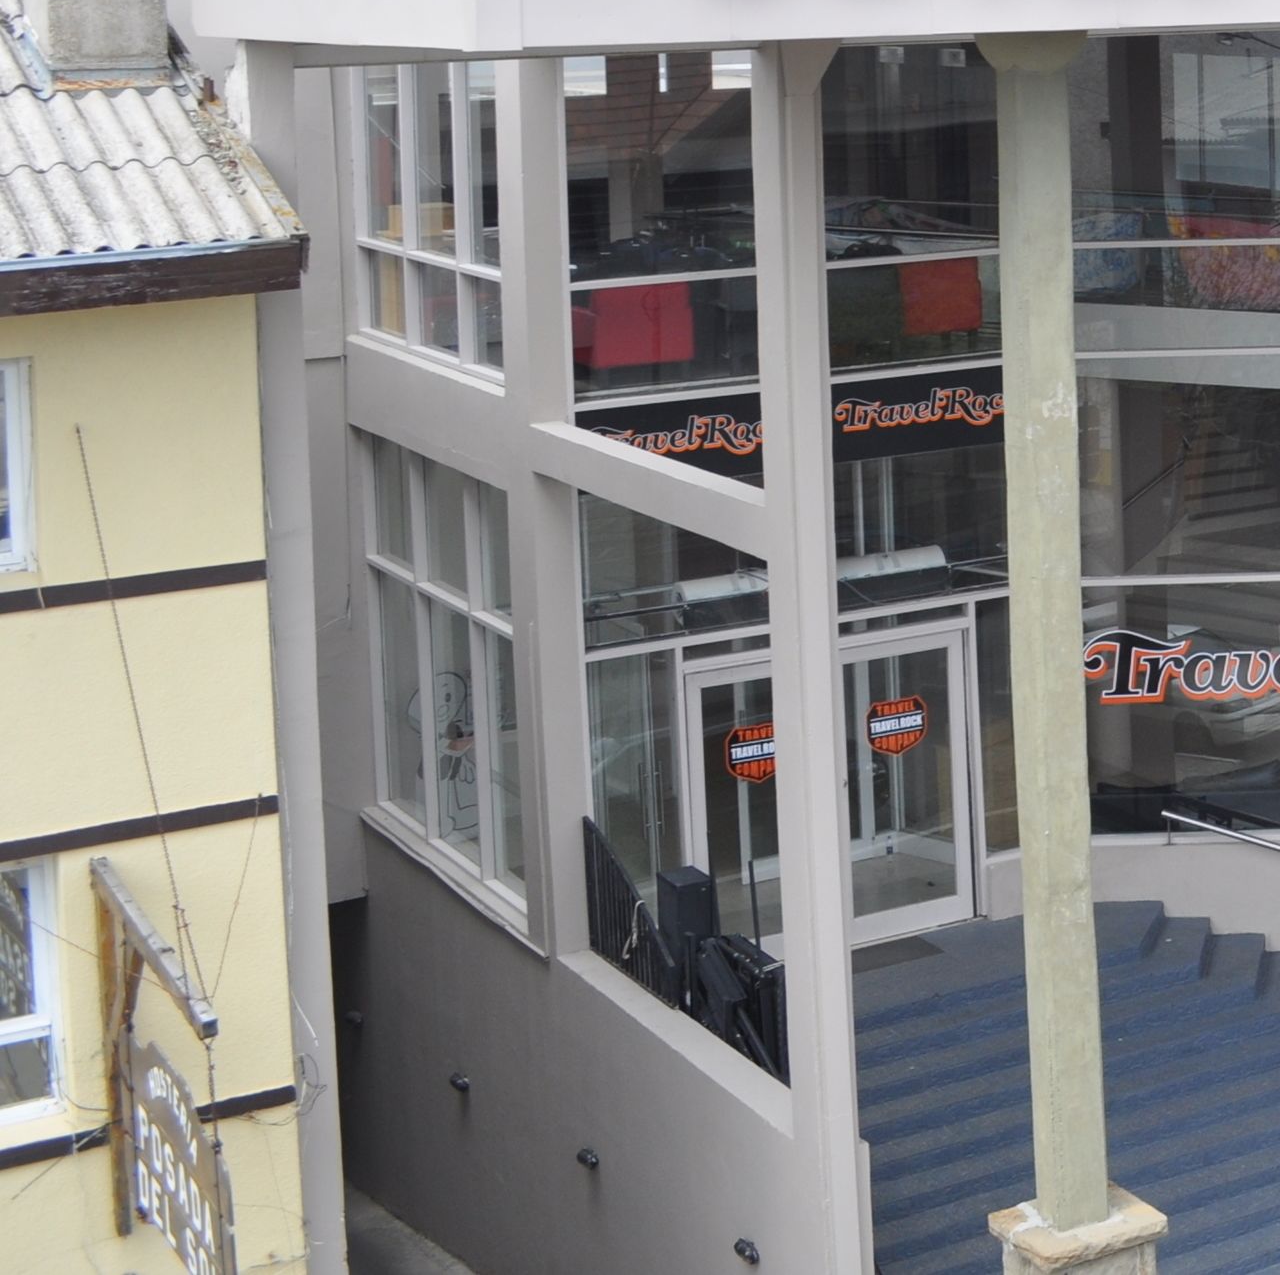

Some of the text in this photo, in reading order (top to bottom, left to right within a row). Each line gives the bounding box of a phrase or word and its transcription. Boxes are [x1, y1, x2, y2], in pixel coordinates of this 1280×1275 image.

[834, 388, 943, 433] Travel
[877, 700, 916, 717] TRAVEL
[147, 1065, 198, 1166] HOSTERIA
[135, 1103, 216, 1256] POSADA
[136, 1158, 216, 1275] DEL SO
